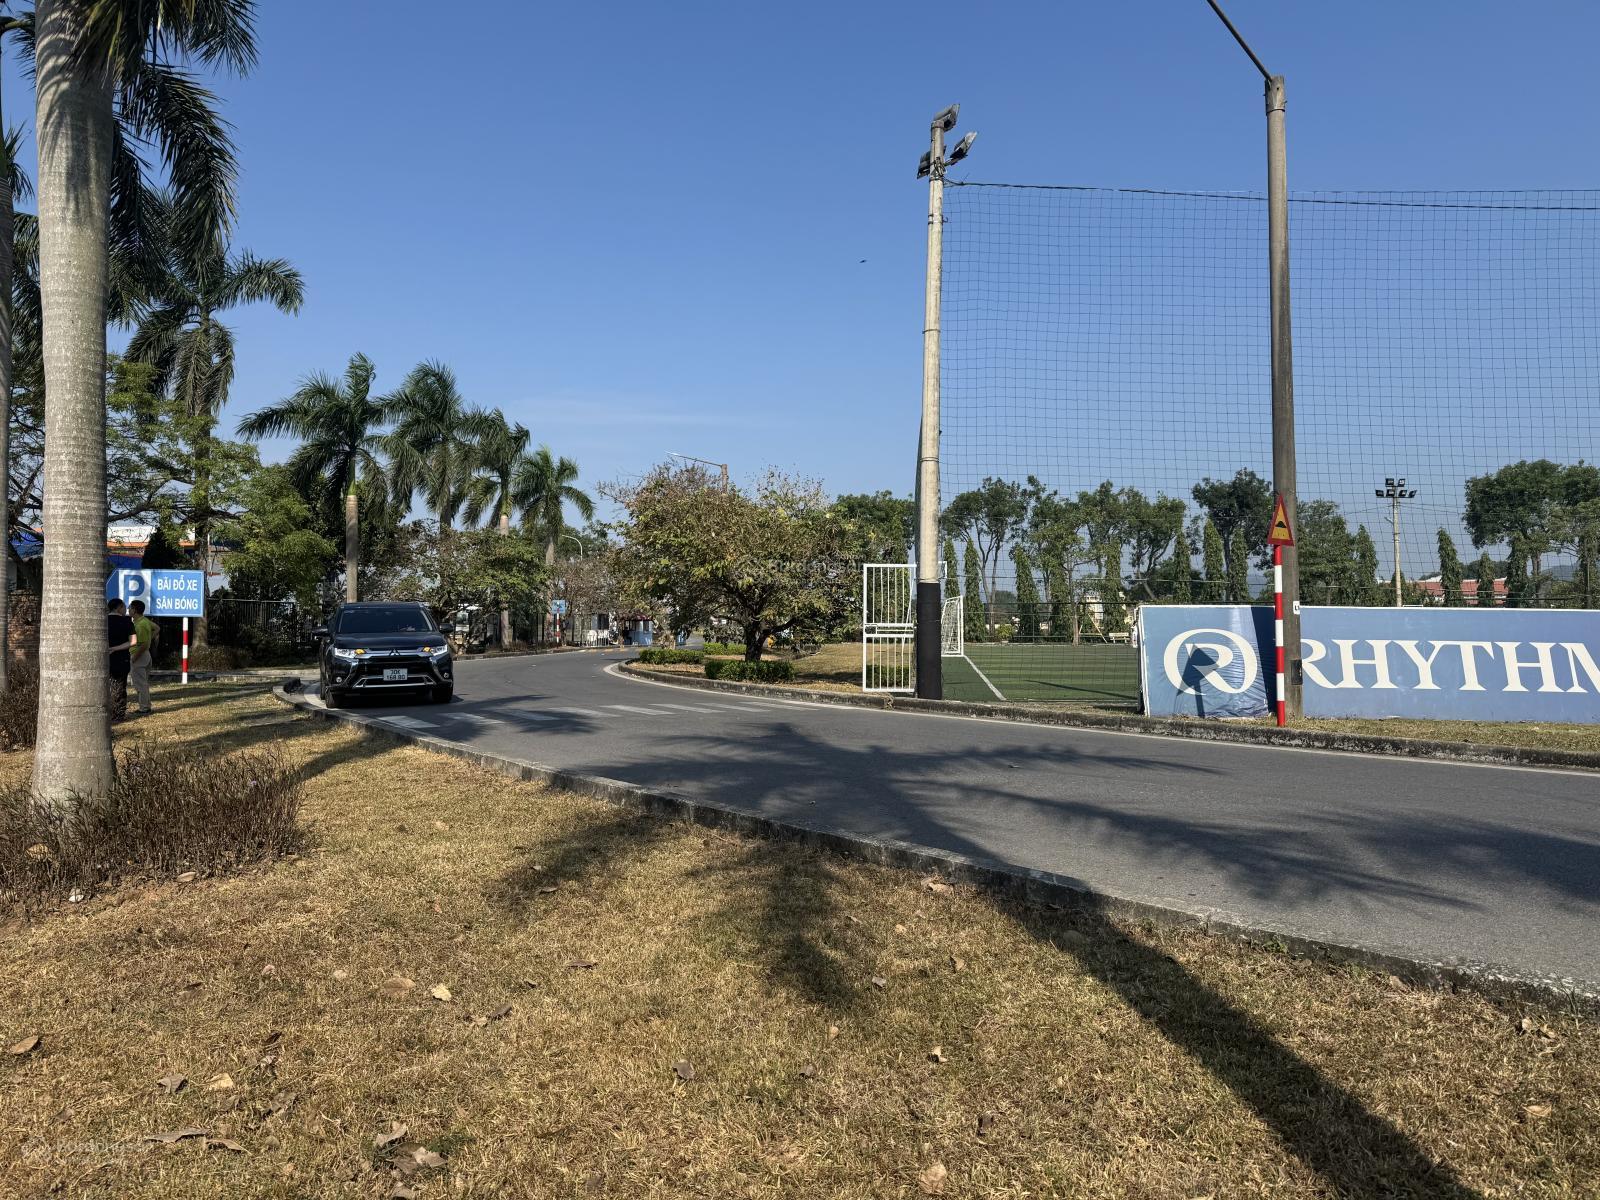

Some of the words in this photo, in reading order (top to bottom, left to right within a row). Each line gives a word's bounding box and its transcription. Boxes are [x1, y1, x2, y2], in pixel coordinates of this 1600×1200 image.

[157, 576, 171, 590] BÃI
[173, 575, 185, 590] ĐỖ
[186, 580, 198, 591] XE
[124, 575, 145, 608] P
[156, 595, 173, 609] SÂN
[174, 596, 198, 610] BÓNG
